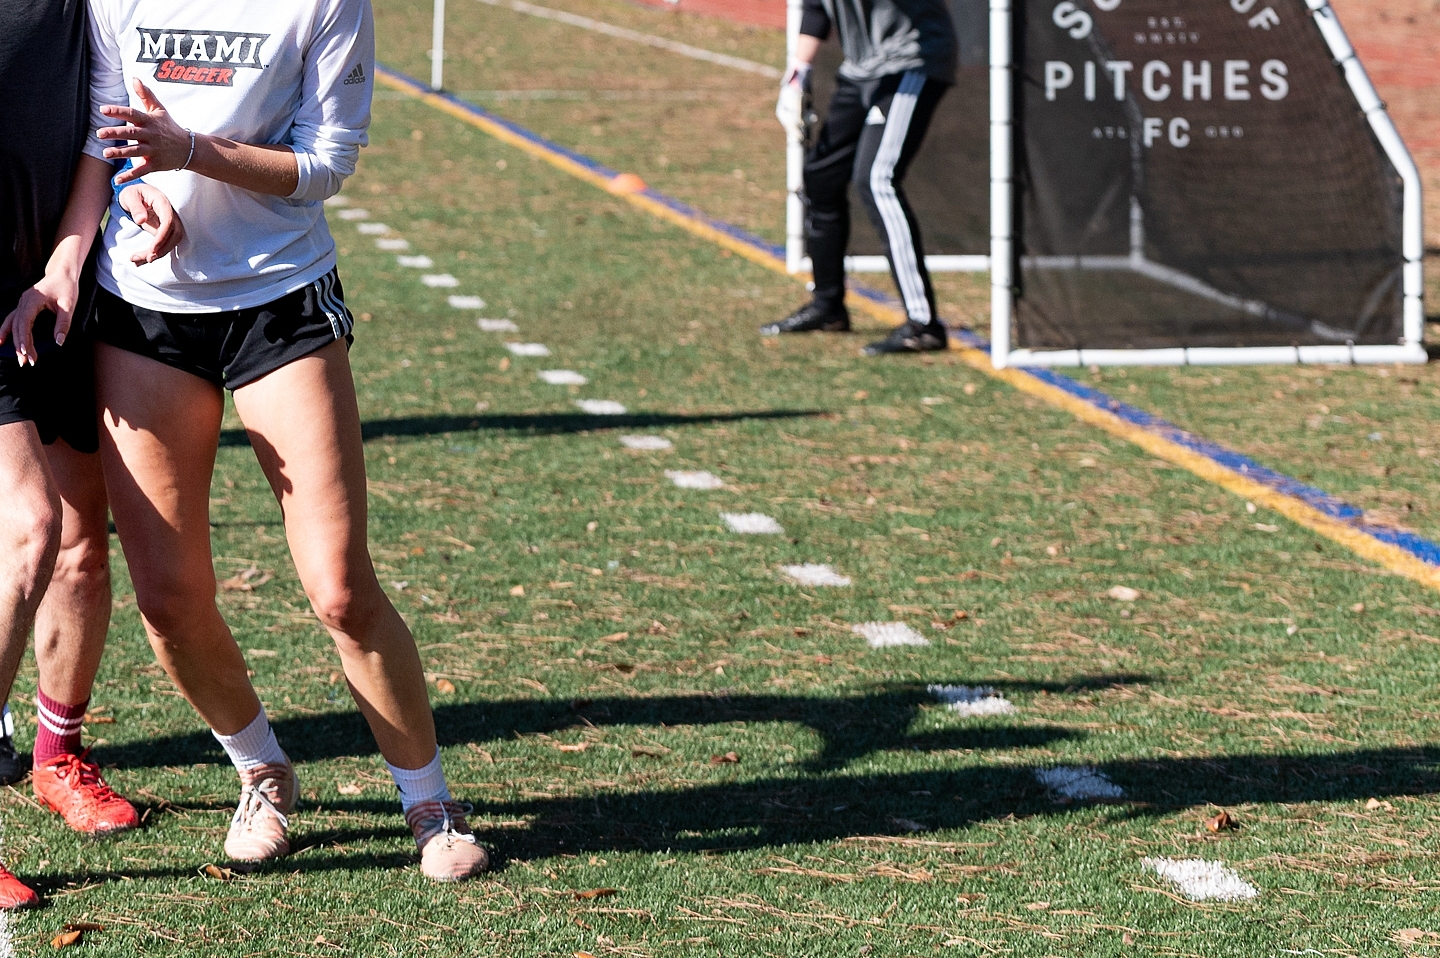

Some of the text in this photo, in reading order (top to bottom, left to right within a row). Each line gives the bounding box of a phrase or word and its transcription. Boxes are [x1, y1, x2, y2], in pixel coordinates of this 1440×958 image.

[142, 32, 262, 64] MIAMI
[1044, 59, 1290, 102] PITCHES
[1143, 117, 1191, 148] FC
